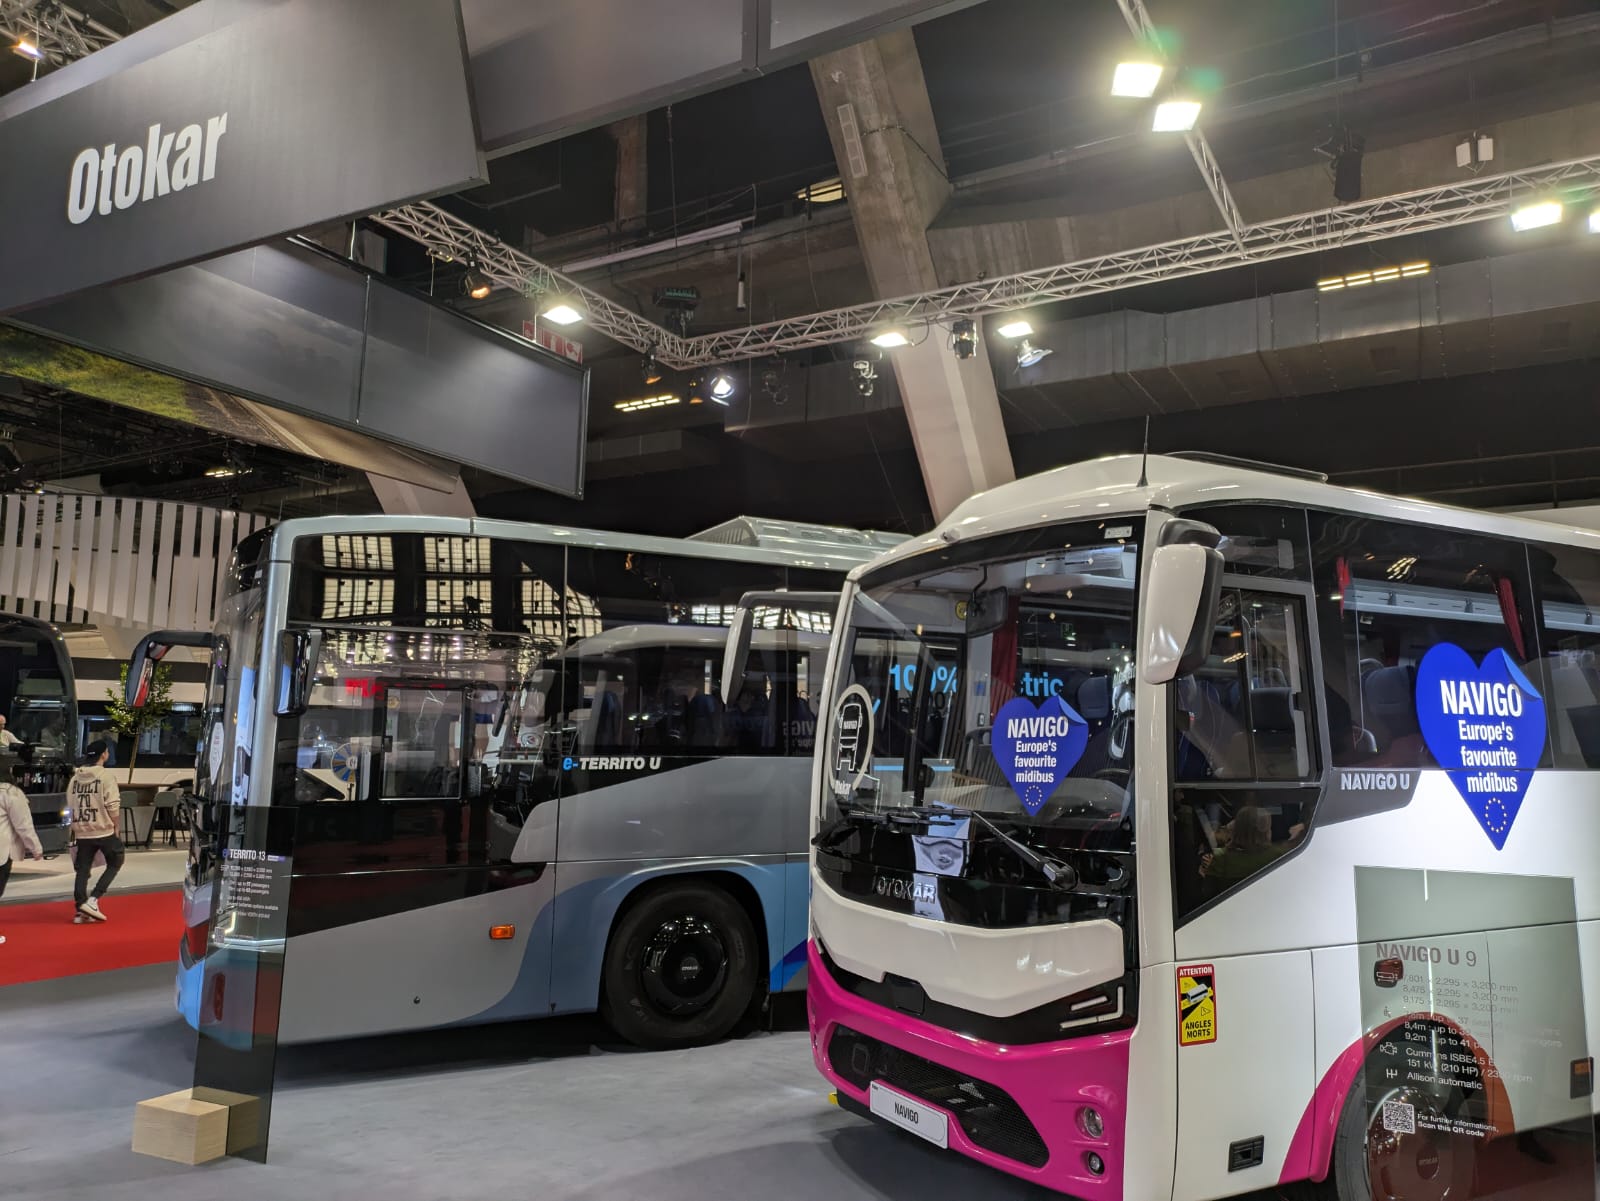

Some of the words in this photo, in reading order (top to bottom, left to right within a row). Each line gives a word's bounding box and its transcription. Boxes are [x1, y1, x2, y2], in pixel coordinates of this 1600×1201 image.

[67, 111, 228, 224] Otokar
[1440, 680, 1523, 717] NAVIGO
[1007, 716, 1069, 738] NAVIGO
[1458, 720, 1514, 745] Europe's
[1016, 740, 1057, 755] Europe's
[562, 757, 646, 771] e-TERRITO
[649, 757, 661, 770] U
[1014, 755, 1057, 768] favourite
[1460, 746, 1517, 767] favourite
[1016, 770, 1054, 783] midibus
[1341, 773, 1397, 790] NAVIGO
[1399, 773, 1410, 790] U
[1467, 771, 1518, 793] midibus
[78, 794, 91, 808] TO
[72, 808, 98, 823] LAST
[259, 851, 266, 861] 13
[1376, 943, 1441, 963] NAVIGO
[1447, 948, 1460, 965] U
[1466, 950, 1477, 967] 9
[1180, 966, 1213, 976] ATTENTION
[1185, 1019, 1212, 1030] ANGLES
[1434, 1026, 1446, 1034] up
[1448, 1026, 1457, 1035] to
[1186, 1029, 1211, 1039] MORTS
[1448, 1038, 1458, 1046] to
[1459, 1039, 1470, 1047] 41
[1405, 1048, 1448, 1060] Cummns
[1407, 1059, 1421, 1067] 151
[1441, 1063, 1460, 1073] (210
[1461, 1066, 1479, 1077] HP)
[1407, 1072, 1436, 1083] Allison
[1438, 1078, 1483, 1089] automatic
[894, 1101, 919, 1124] NAVIGO
[1417, 1113, 1429, 1121] For
[1430, 1115, 1453, 1125] further
[1418, 1121, 1436, 1130] Scan
[1437, 1123, 1451, 1132] this
[1452, 1126, 1465, 1134] QR
[1466, 1128, 1485, 1137] code
